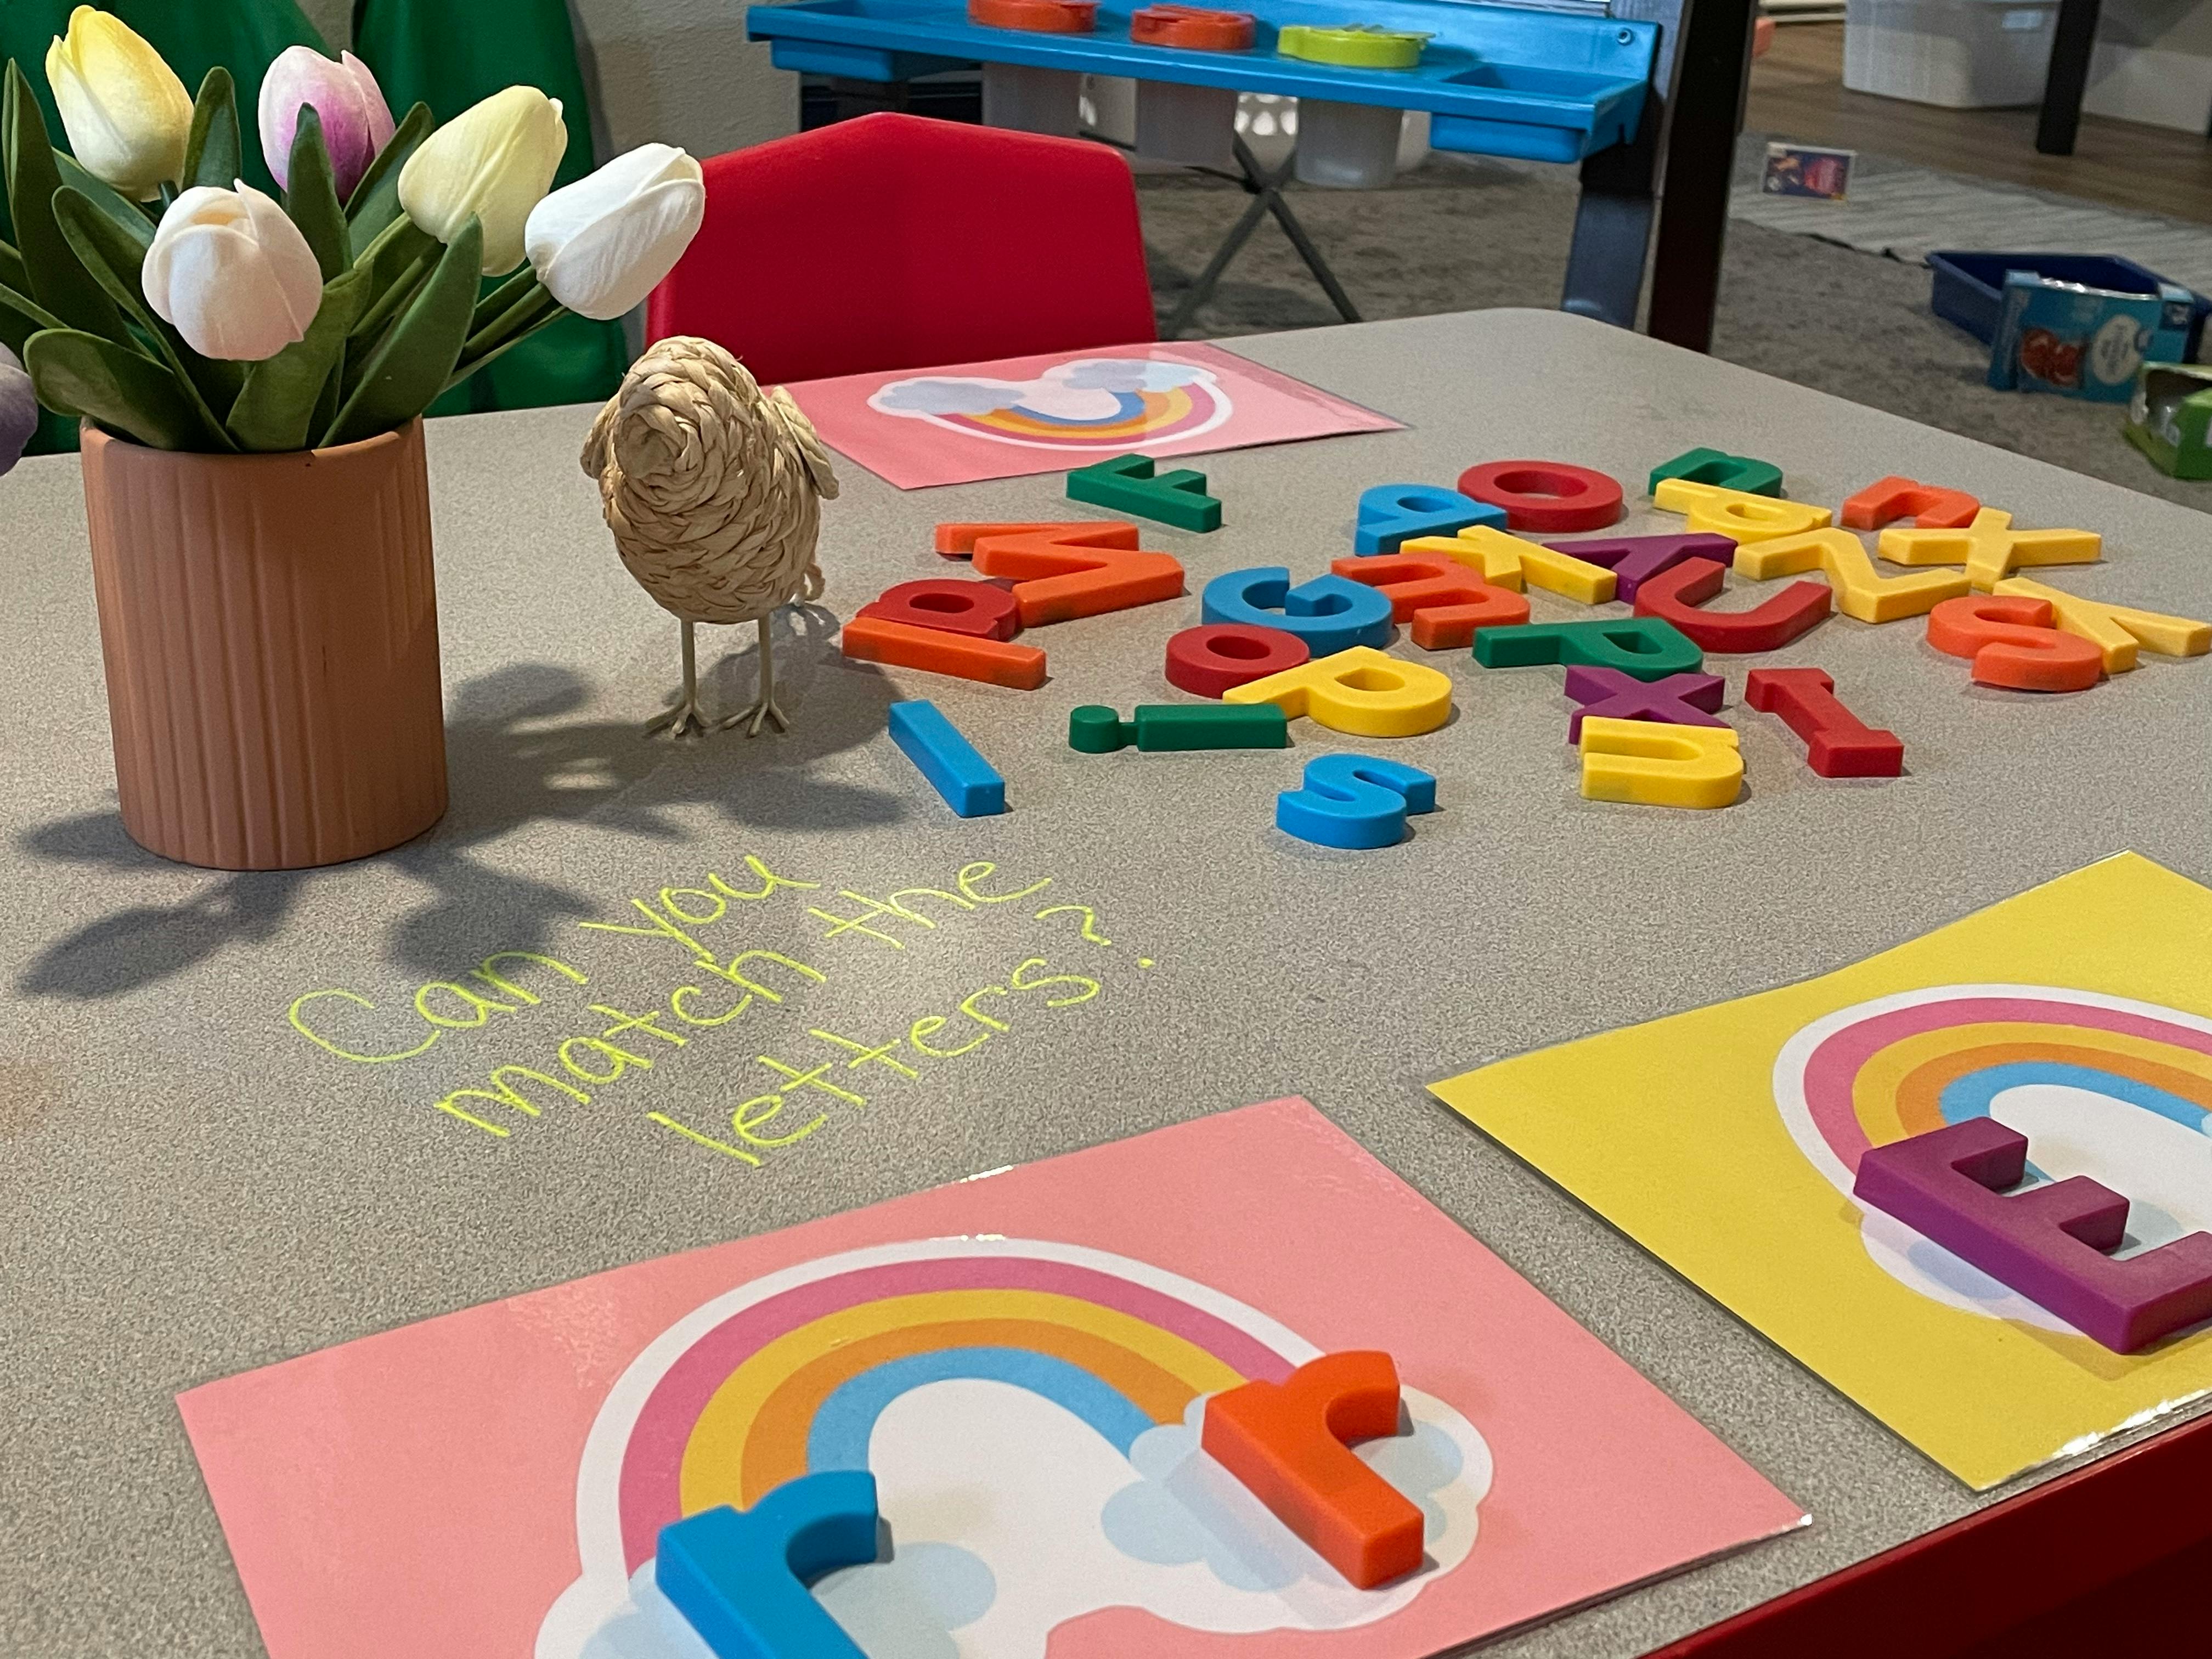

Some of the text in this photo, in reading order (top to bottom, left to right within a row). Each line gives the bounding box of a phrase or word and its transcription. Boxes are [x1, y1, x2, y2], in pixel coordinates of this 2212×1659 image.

[287, 953, 588, 1063] Can
[433, 861, 1052, 1139] match the
[1853, 1116, 2212, 1355] E
